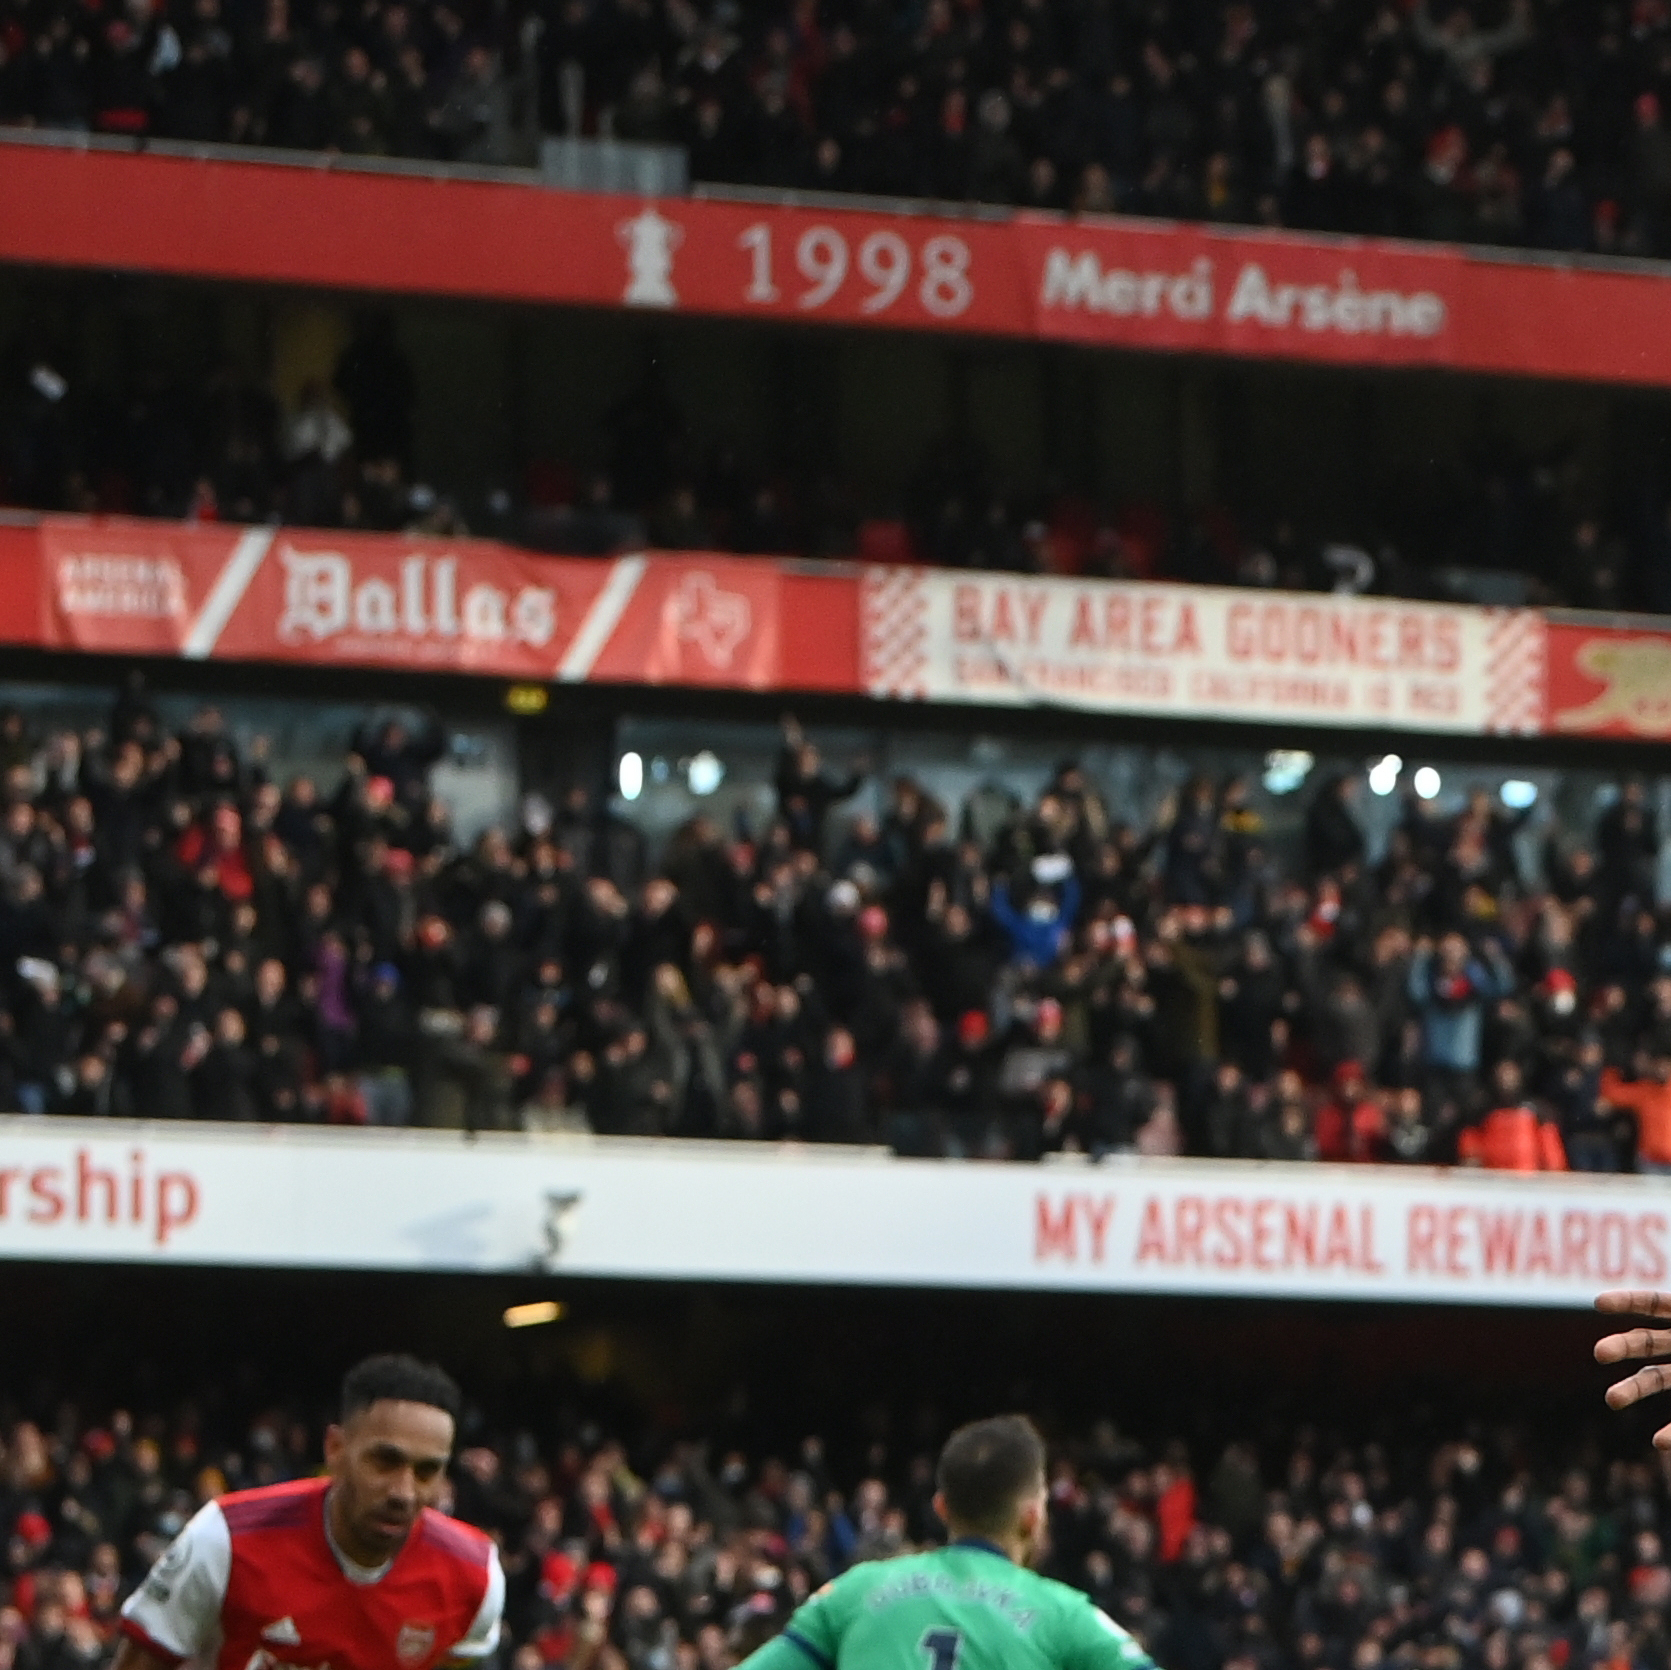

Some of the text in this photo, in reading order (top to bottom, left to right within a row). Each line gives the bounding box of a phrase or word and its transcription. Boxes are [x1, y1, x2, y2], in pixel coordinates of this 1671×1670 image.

[736, 222, 975, 319] 1998
[1041, 246, 1449, 339] Merci Arsène
[276, 545, 556, 648] Dallas
[951, 583, 1463, 673] BAY AREA GOONERS
[1034, 1191, 1668, 1284] MY ARSENAL REWARDS
